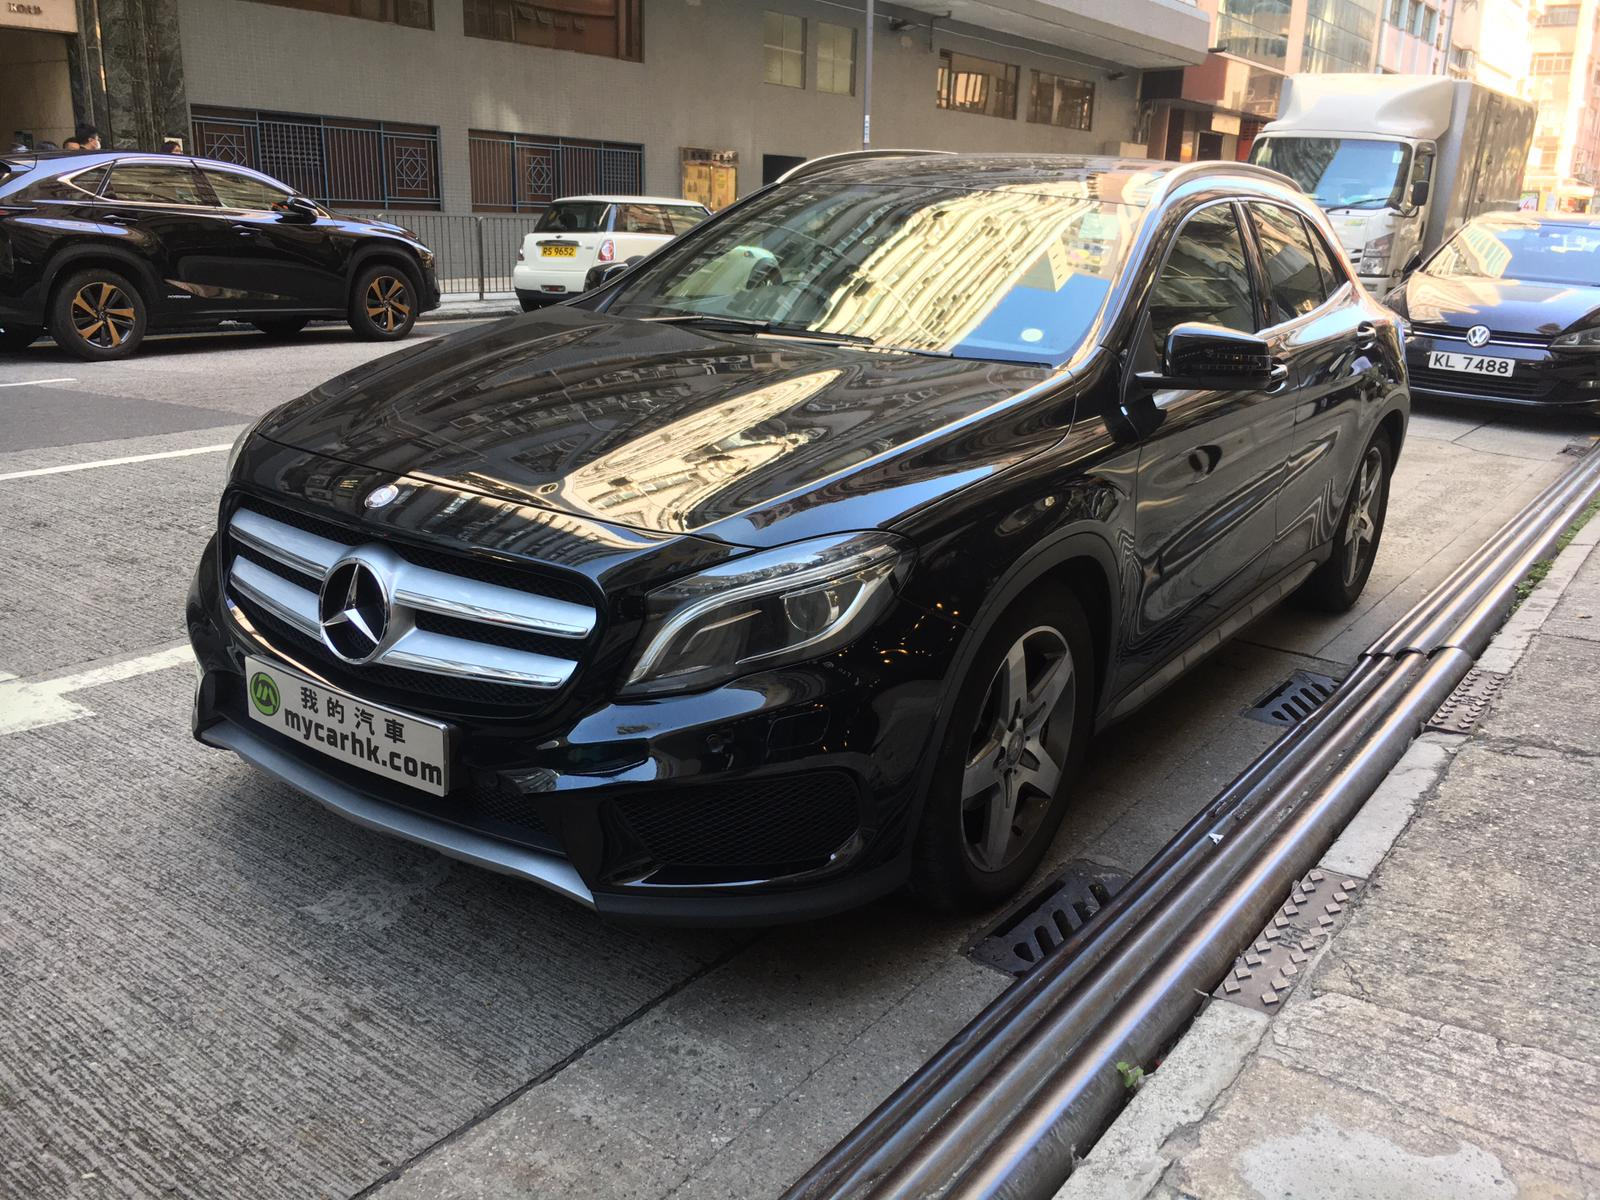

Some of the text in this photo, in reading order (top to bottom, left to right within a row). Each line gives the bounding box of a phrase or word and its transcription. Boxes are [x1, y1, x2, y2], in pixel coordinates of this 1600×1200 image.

[543, 247, 553, 256] RS
[554, 247, 575, 256] 9652
[1433, 353, 1509, 374] KL 7488
[300, 686, 406, 744] 我的汽車
[284, 708, 442, 786] mycarhk.com
